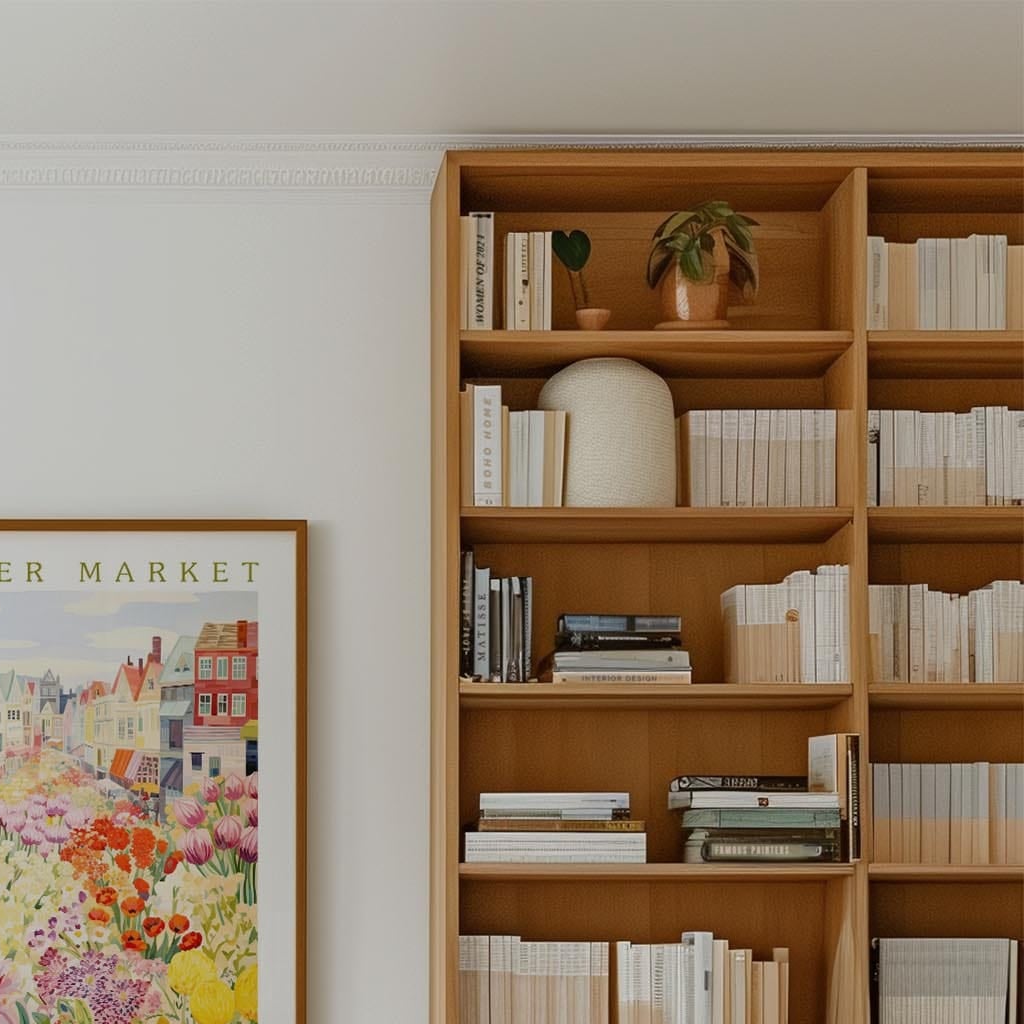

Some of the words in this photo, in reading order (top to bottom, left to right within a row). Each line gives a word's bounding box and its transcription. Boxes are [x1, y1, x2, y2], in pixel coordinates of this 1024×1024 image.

[475, 258, 486, 276] OF
[475, 278, 485, 323] WOMEN
[483, 397, 492, 440] HOME
[483, 447, 492, 489] BOHO
[79, 561, 260, 583] MARKET
[477, 592, 487, 662] MATISSE
[714, 845, 748, 855] FAMOUS
[750, 845, 790, 855] PAINTERS
